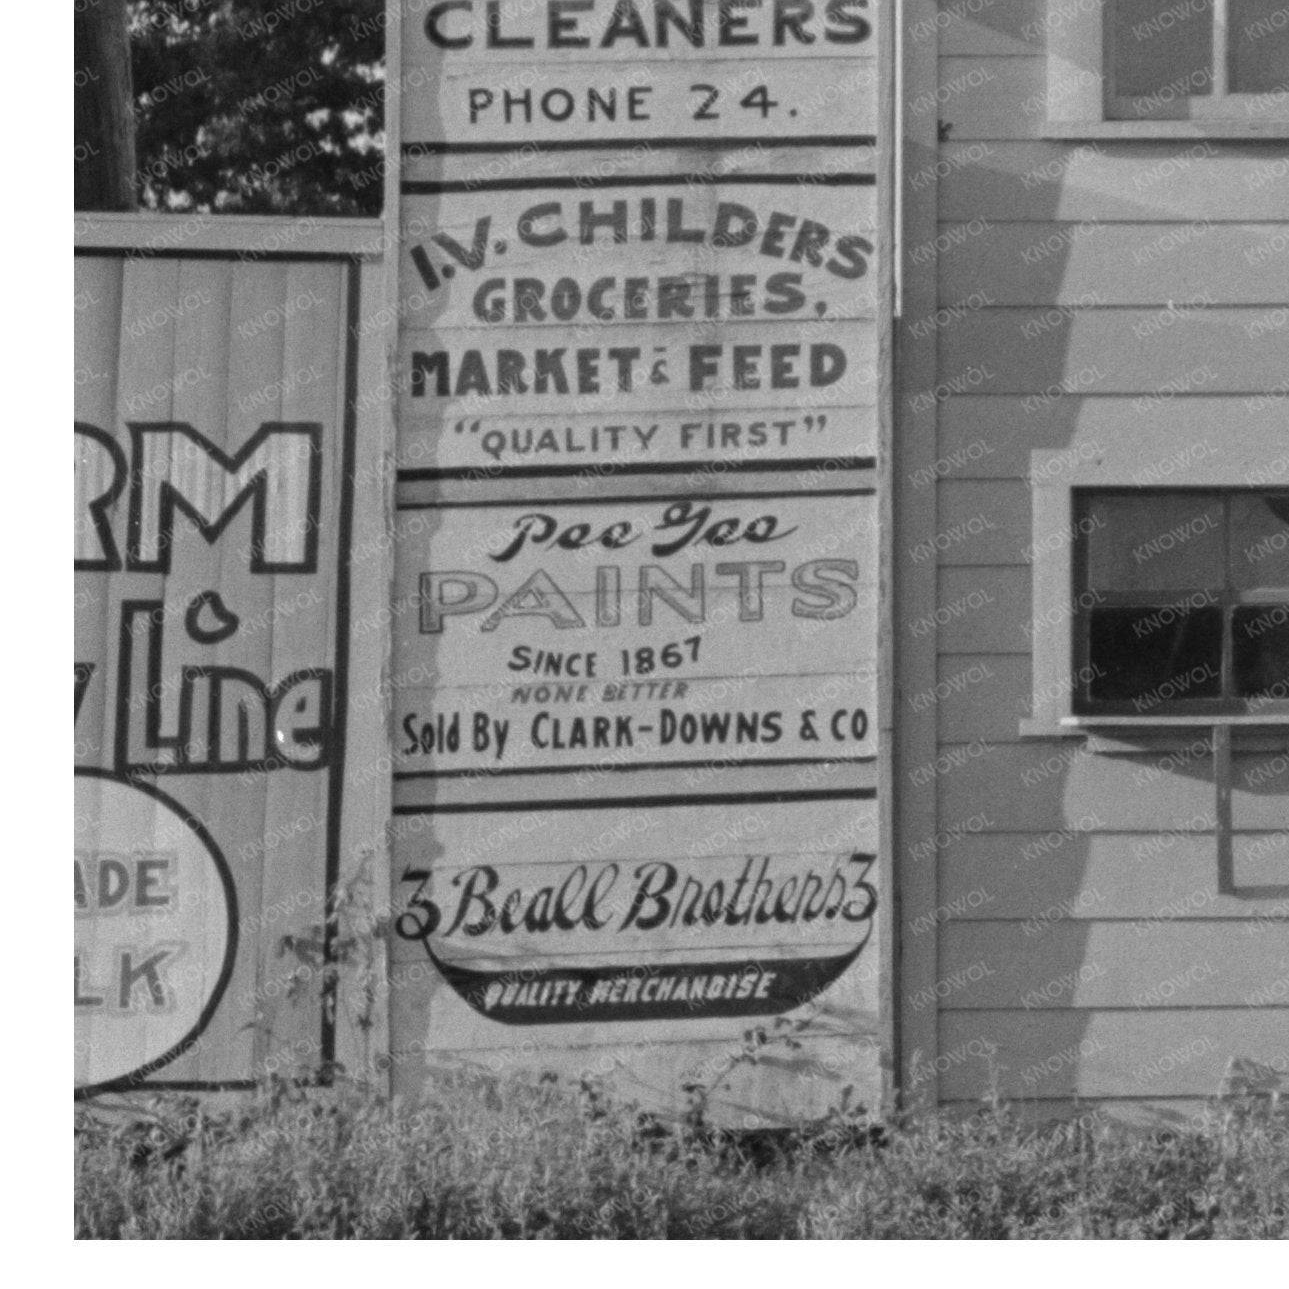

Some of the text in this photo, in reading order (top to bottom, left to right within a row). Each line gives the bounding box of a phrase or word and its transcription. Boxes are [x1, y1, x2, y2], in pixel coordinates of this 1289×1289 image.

[468, 84, 799, 123] PHONE 24.
[472, 272, 828, 323] GROCERIES,
[410, 347, 641, 397] MARKET
[689, 343, 848, 392] FEED
[454, 415, 827, 456] "QUALITY FIRST"
[488, 513, 643, 562] Pee
[419, 558, 859, 634] PAINTS
[508, 635, 702, 679] SINCE 1867
[511, 681, 689, 704] NONE BETTER
[402, 708, 869, 758] Sold By CLARK-DOWNS & CO
[395, 865, 442, 940] 3
[443, 862, 620, 937] Beall
[485, 971, 776, 1010] QUALITY MERCHANDISE
